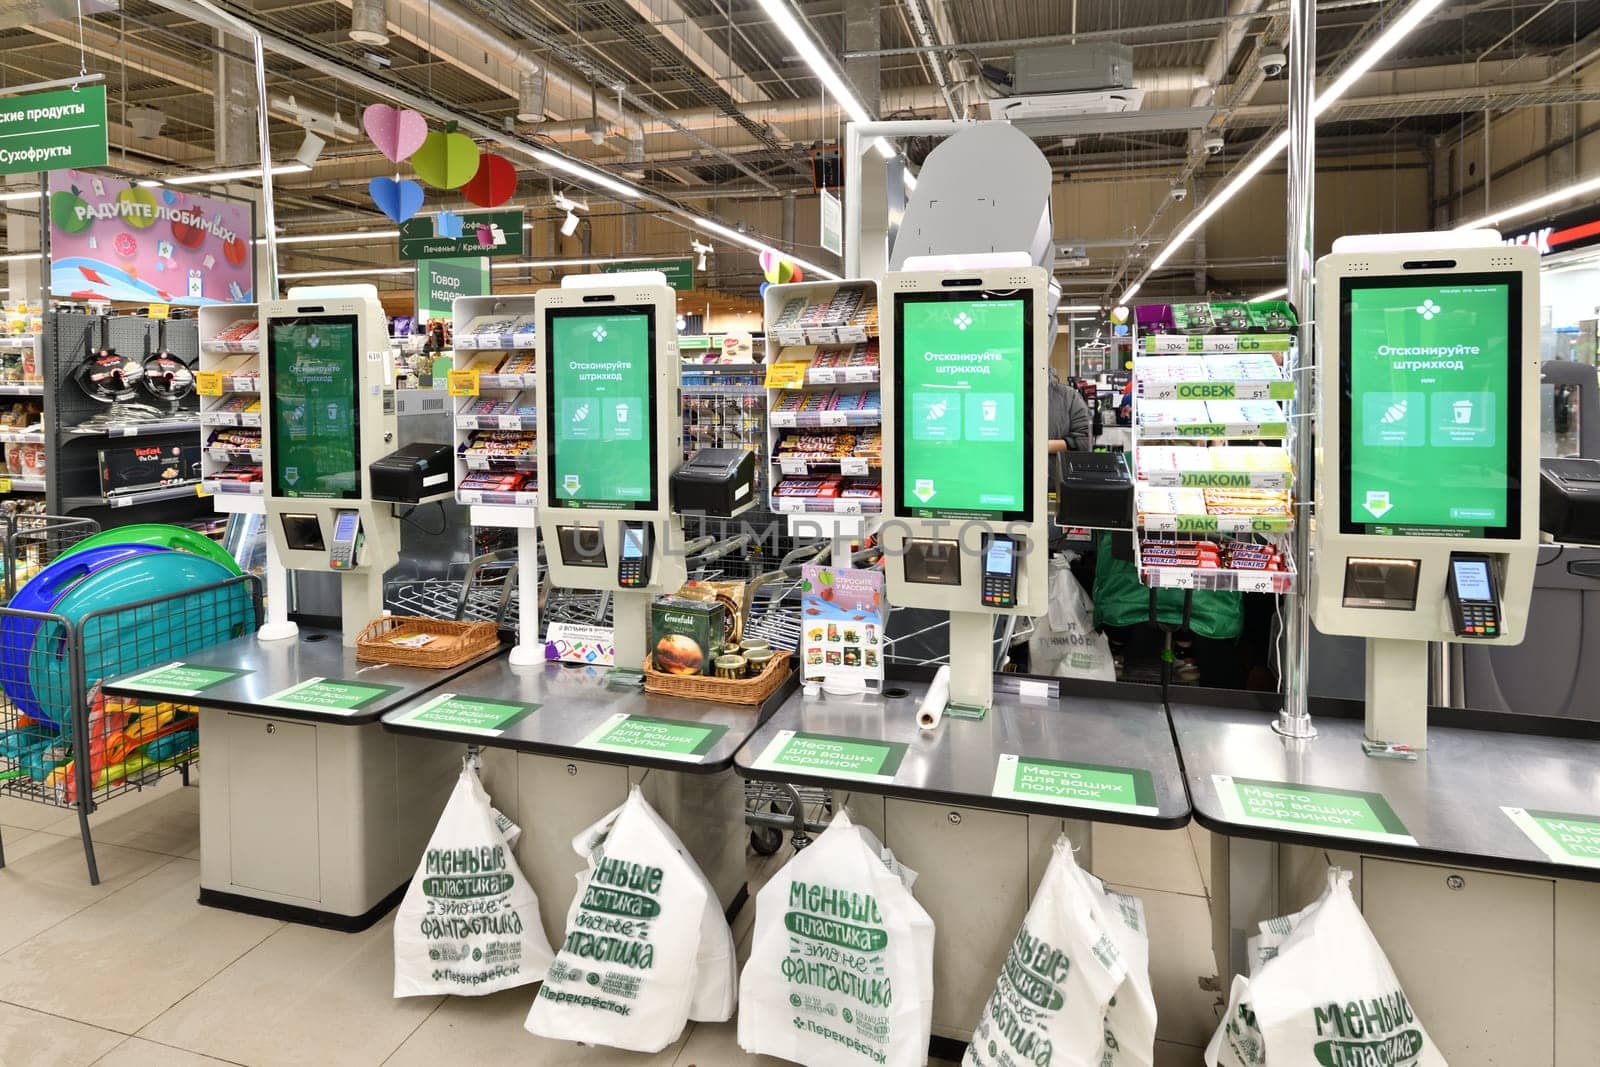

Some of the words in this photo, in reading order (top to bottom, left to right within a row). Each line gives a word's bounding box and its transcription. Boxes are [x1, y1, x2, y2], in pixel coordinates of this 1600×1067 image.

[27, 103, 85, 121] продукты
[0, 145, 72, 163] Сухофрукты
[74, 199, 152, 221] РАДУЙТЕ
[154, 206, 237, 245] ЛЮБИМЫХ!
[423, 244, 456, 254] Печенье
[430, 271, 461, 289] Товар
[923, 351, 1003, 362] Отсканируйте
[1377, 344, 1480, 357] Отсканируйте
[569, 360, 632, 372] Отсканируйте
[935, 365, 990, 375] штрихкод
[1393, 360, 1464, 372] штрихкод
[579, 373, 623, 382] штрихкод
[1179, 385, 1235, 397] ОСВЕЖ
[1232, 560, 1266, 568] SNICKERS
[664, 613, 694, 625] Greenfield
[623, 721, 668, 733] Место
[607, 735, 670, 748] покупок
[616, 729, 641, 737] для
[643, 732, 694, 744] ваших
[793, 740, 843, 752] Место
[781, 755, 861, 769] корзинок
[786, 748, 816, 757] для
[820, 752, 875, 764] ваших
[1023, 766, 1083, 778] Место
[1021, 774, 1056, 785] для
[1060, 779, 1124, 793] ваших
[1021, 782, 1101, 798] покупок
[1243, 787, 1312, 803] Место
[1248, 799, 1285, 809] для
[1291, 804, 1364, 818] ваших
[1249, 807, 1356, 825] корзинок
[803, 941, 839, 963] это
[842, 954, 868, 973] не
